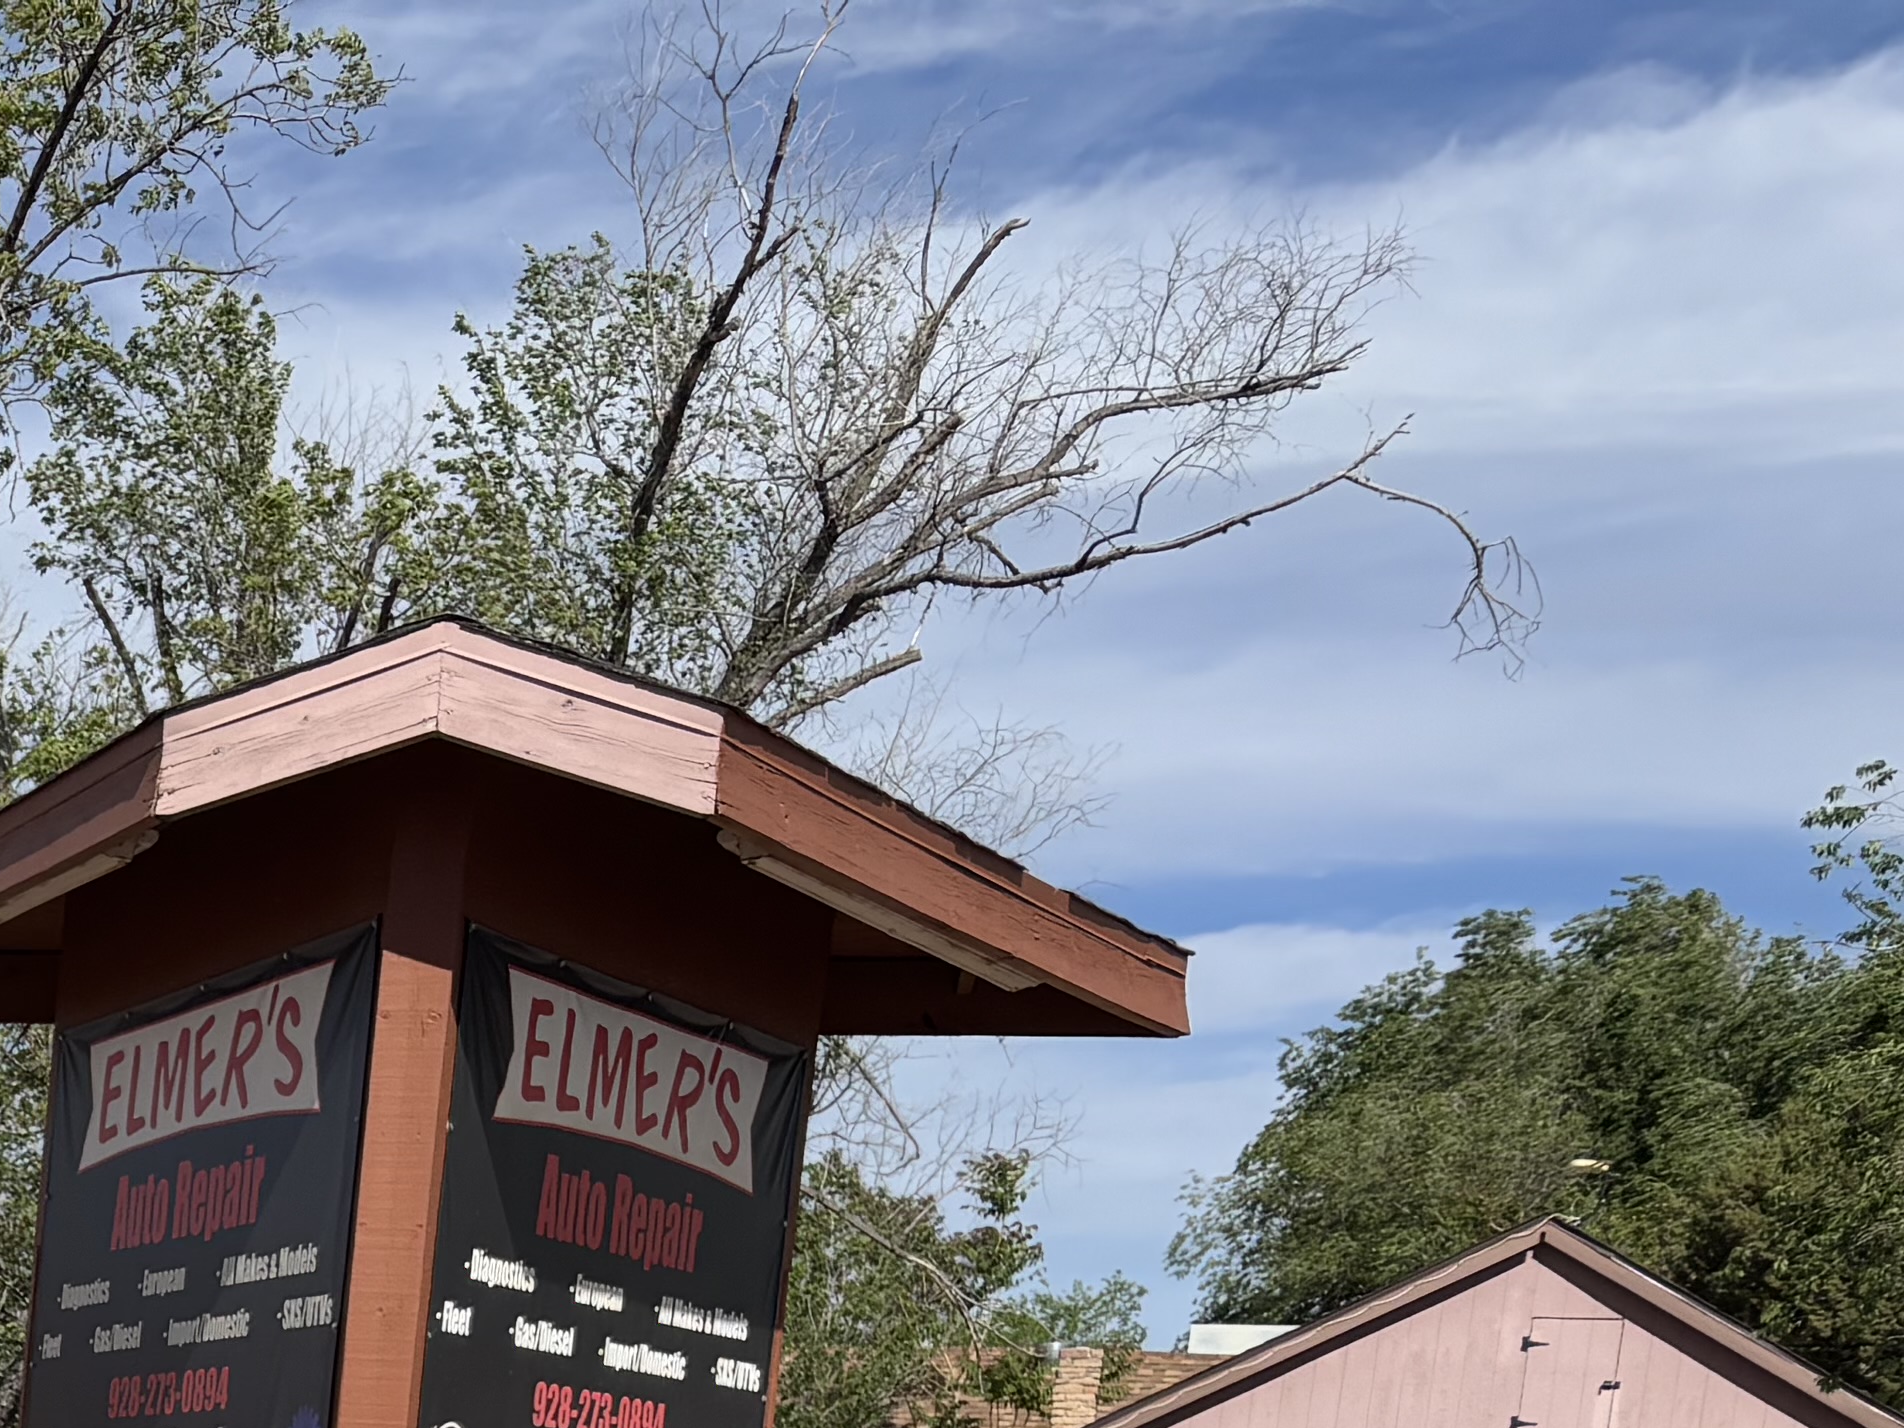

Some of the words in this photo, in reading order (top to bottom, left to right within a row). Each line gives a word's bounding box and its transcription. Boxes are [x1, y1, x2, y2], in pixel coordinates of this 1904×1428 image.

[99, 984, 303, 1144] ELMER'S
[521, 997, 740, 1167] ELMER'S
[111, 1174, 169, 1250] Auto
[172, 1144, 266, 1241] Repair
[535, 1153, 607, 1250] Auto
[609, 1173, 704, 1273] Repair
[61, 1278, 110, 1310] Diagnostics
[143, 1267, 185, 1296] European
[220, 1256, 236, 1286] All
[235, 1253, 269, 1284] Makes
[269, 1253, 277, 1279] &
[278, 1242, 317, 1277] Models
[470, 1248, 536, 1293] Diagnostics
[575, 1273, 624, 1312] European
[658, 1296, 673, 1326] All
[672, 1298, 704, 1333] Makes
[704, 1310, 712, 1334] &
[712, 1307, 749, 1341] Models
[94, 1321, 142, 1353] Gas/Diesel
[167, 1308, 250, 1347] Import/Domestic
[441, 1300, 472, 1336] Fleet
[514, 1315, 575, 1357] Gas/Diesel
[603, 1336, 686, 1381] Import/Domestic
[108, 1366, 229, 1418] 928-273-0894
